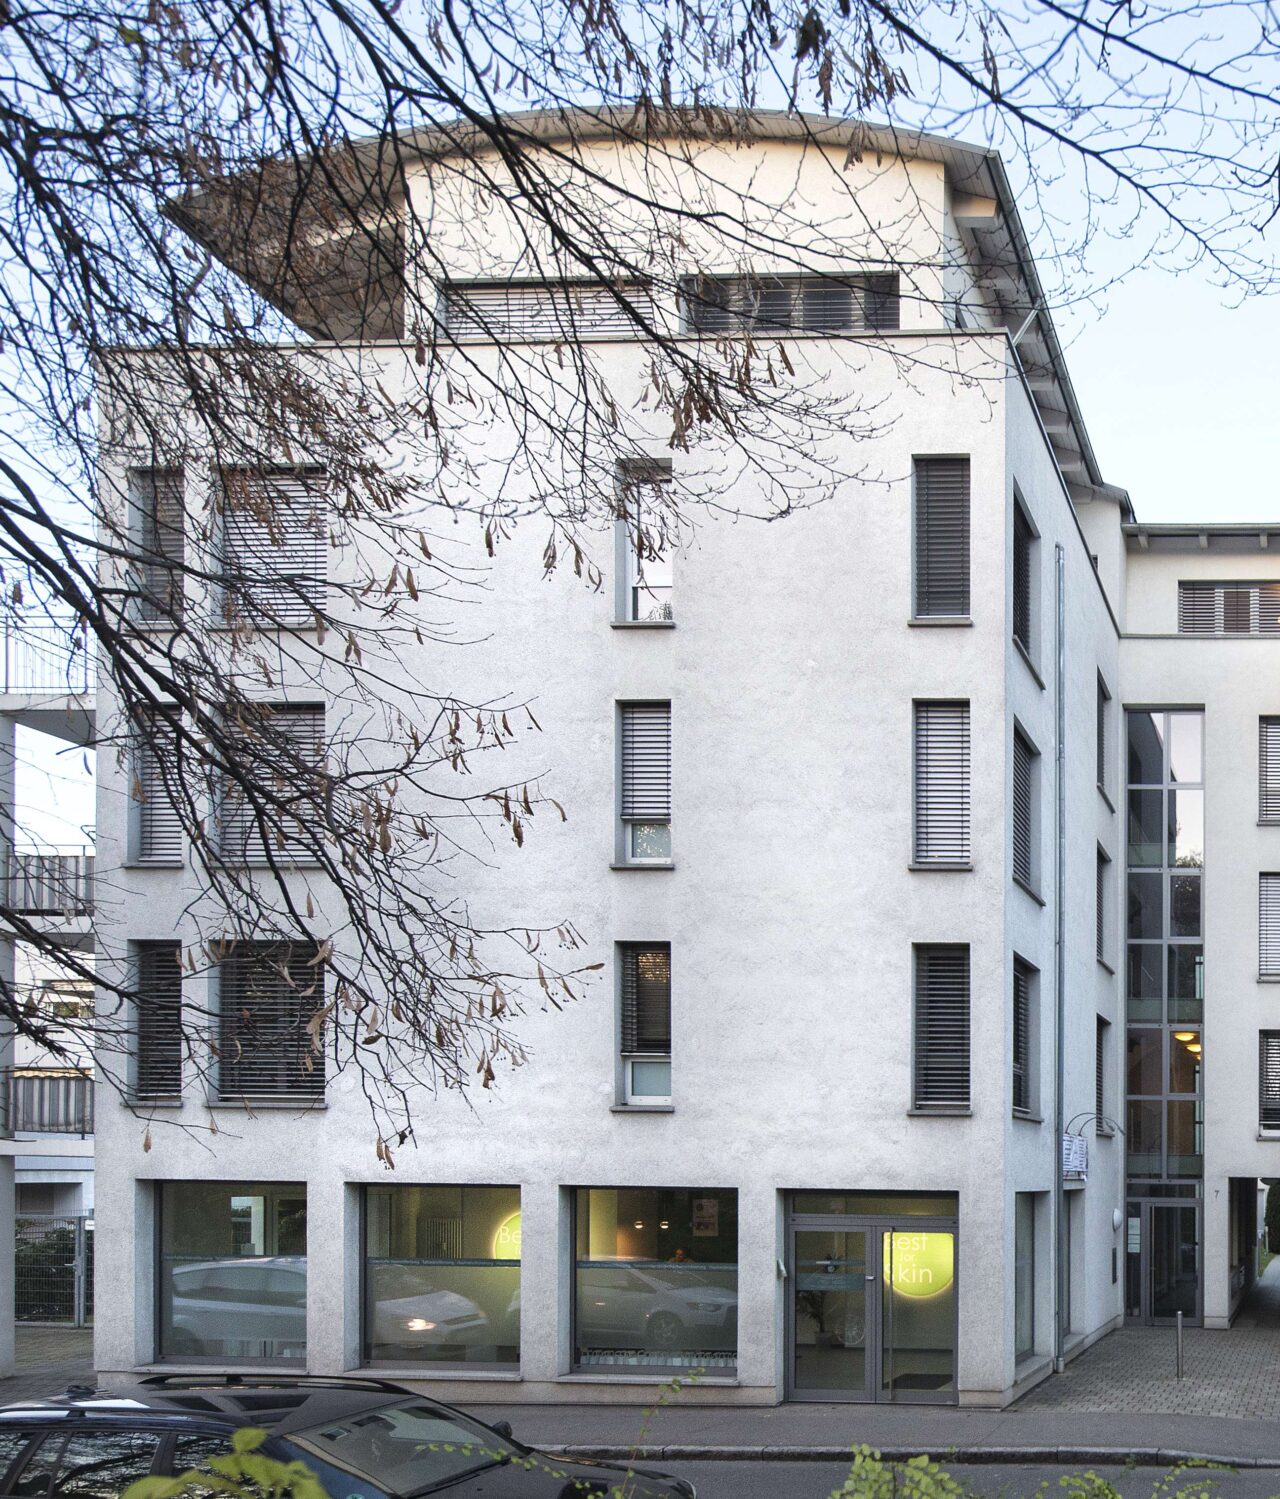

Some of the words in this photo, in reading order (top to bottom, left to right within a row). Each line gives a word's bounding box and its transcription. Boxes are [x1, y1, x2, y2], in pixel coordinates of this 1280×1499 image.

[1214, 1190, 1219, 1199] 7
[500, 1226, 521, 1244] Be
[900, 1252, 915, 1262] for
